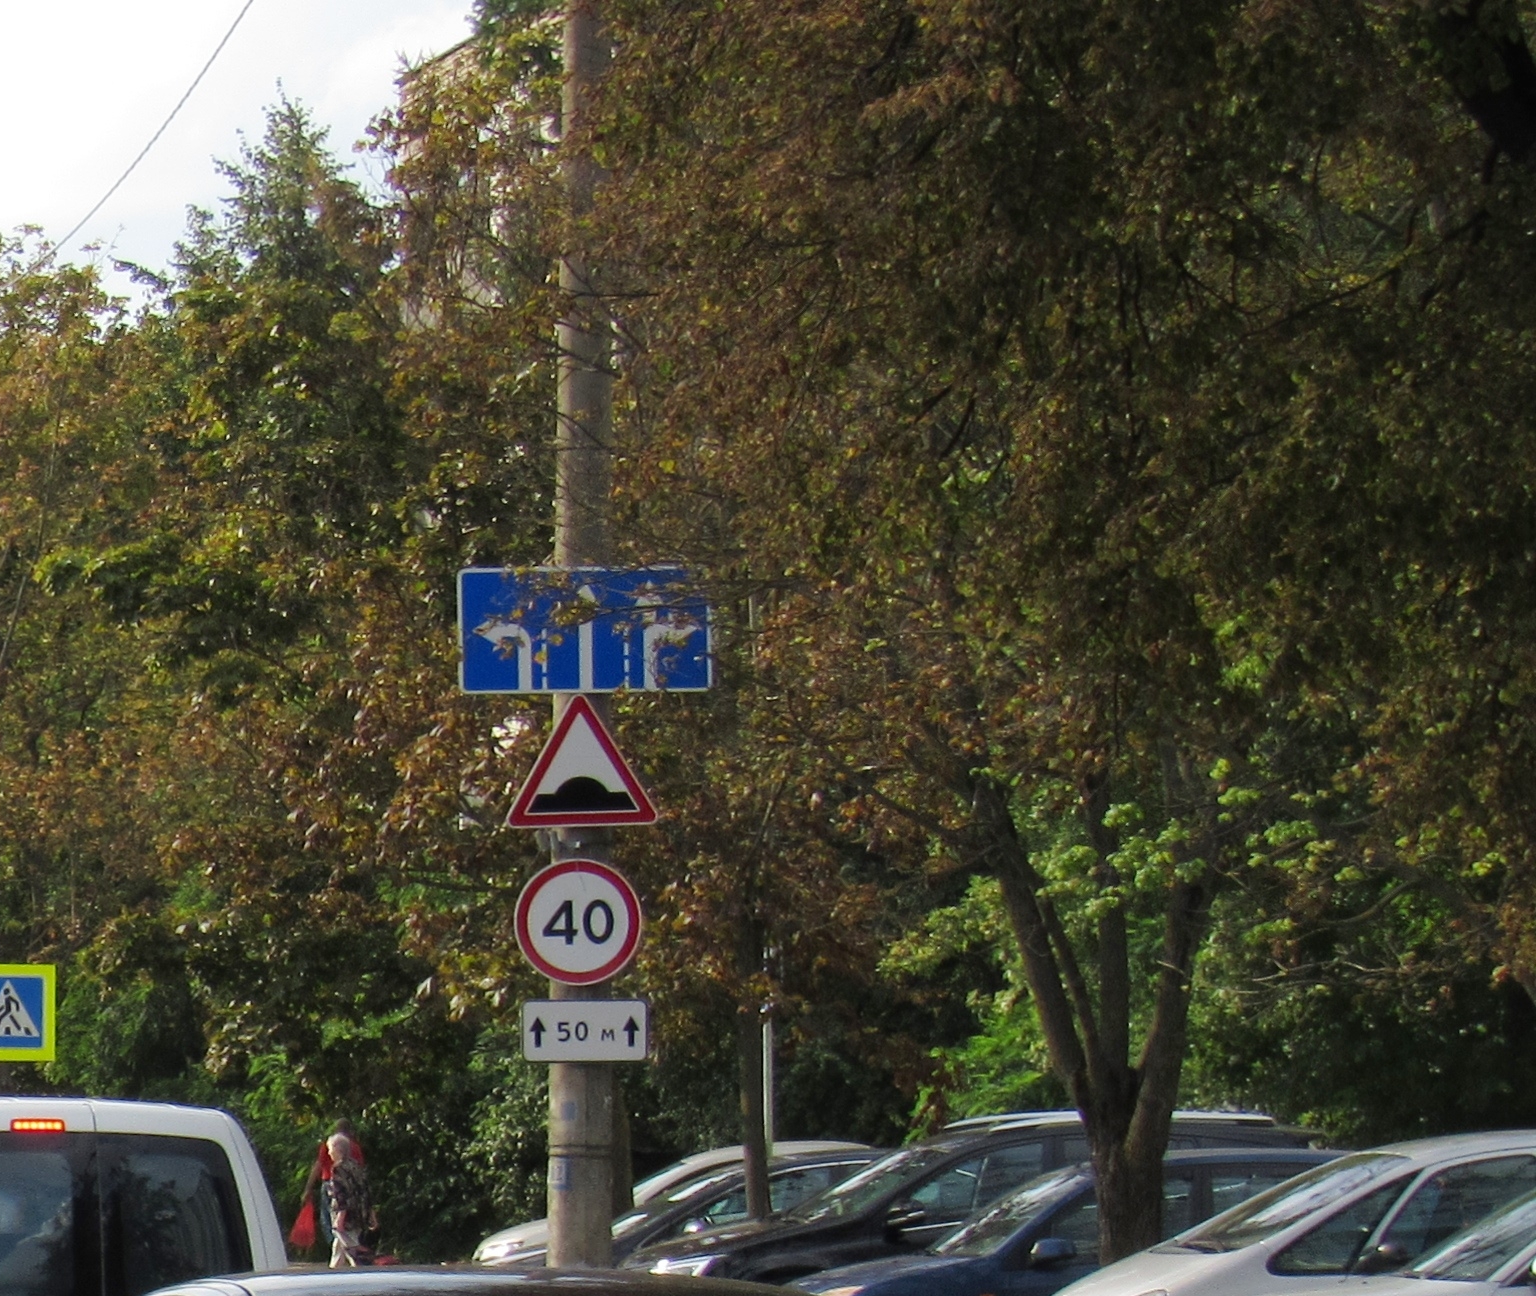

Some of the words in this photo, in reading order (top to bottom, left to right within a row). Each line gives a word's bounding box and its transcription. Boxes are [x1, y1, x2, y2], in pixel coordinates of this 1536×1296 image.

[542, 899, 614, 945] 40
[556, 1021, 589, 1042] 50
[600, 1029, 616, 1042] м
